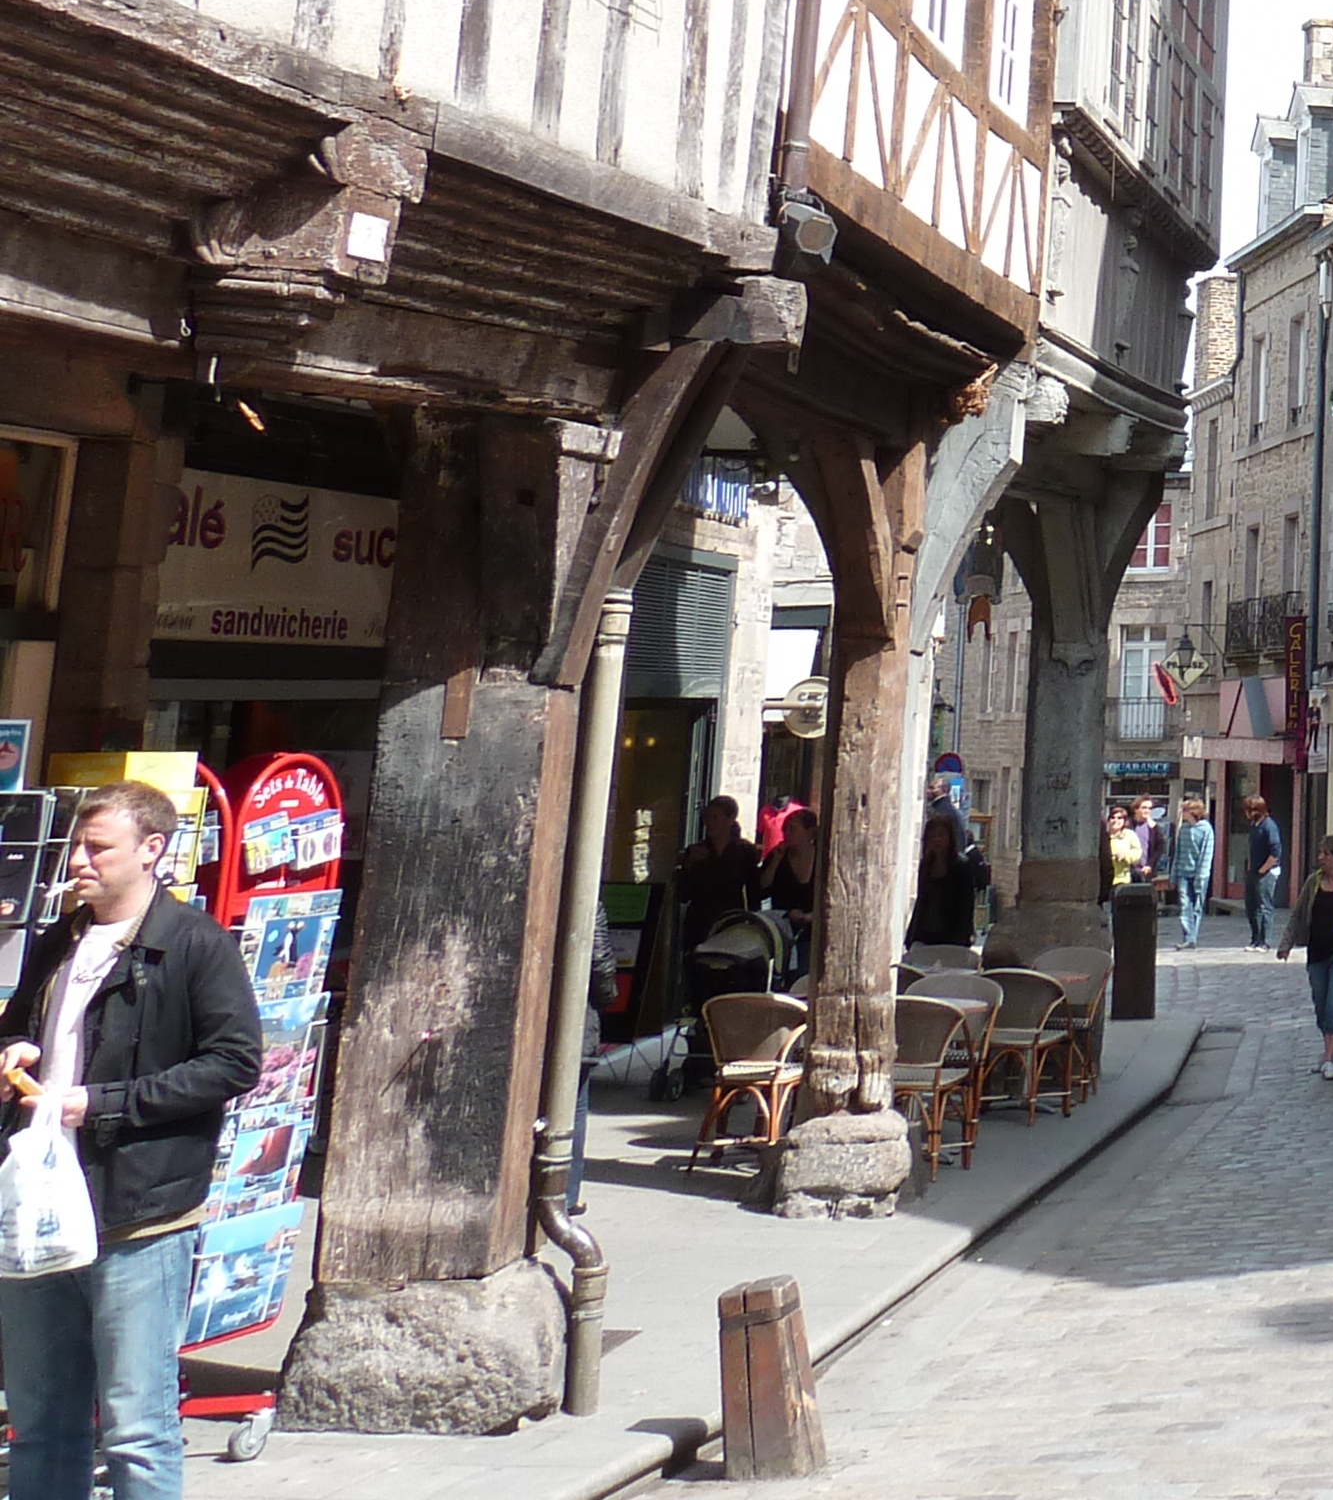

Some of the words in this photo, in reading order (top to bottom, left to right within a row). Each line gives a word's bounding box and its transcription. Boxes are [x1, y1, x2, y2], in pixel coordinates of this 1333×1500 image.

[211, 605, 348, 641] sandwicherie
[1288, 622, 1304, 718] GALERIE
[253, 777, 283, 809] Sets
[296, 768, 326, 807] Table
